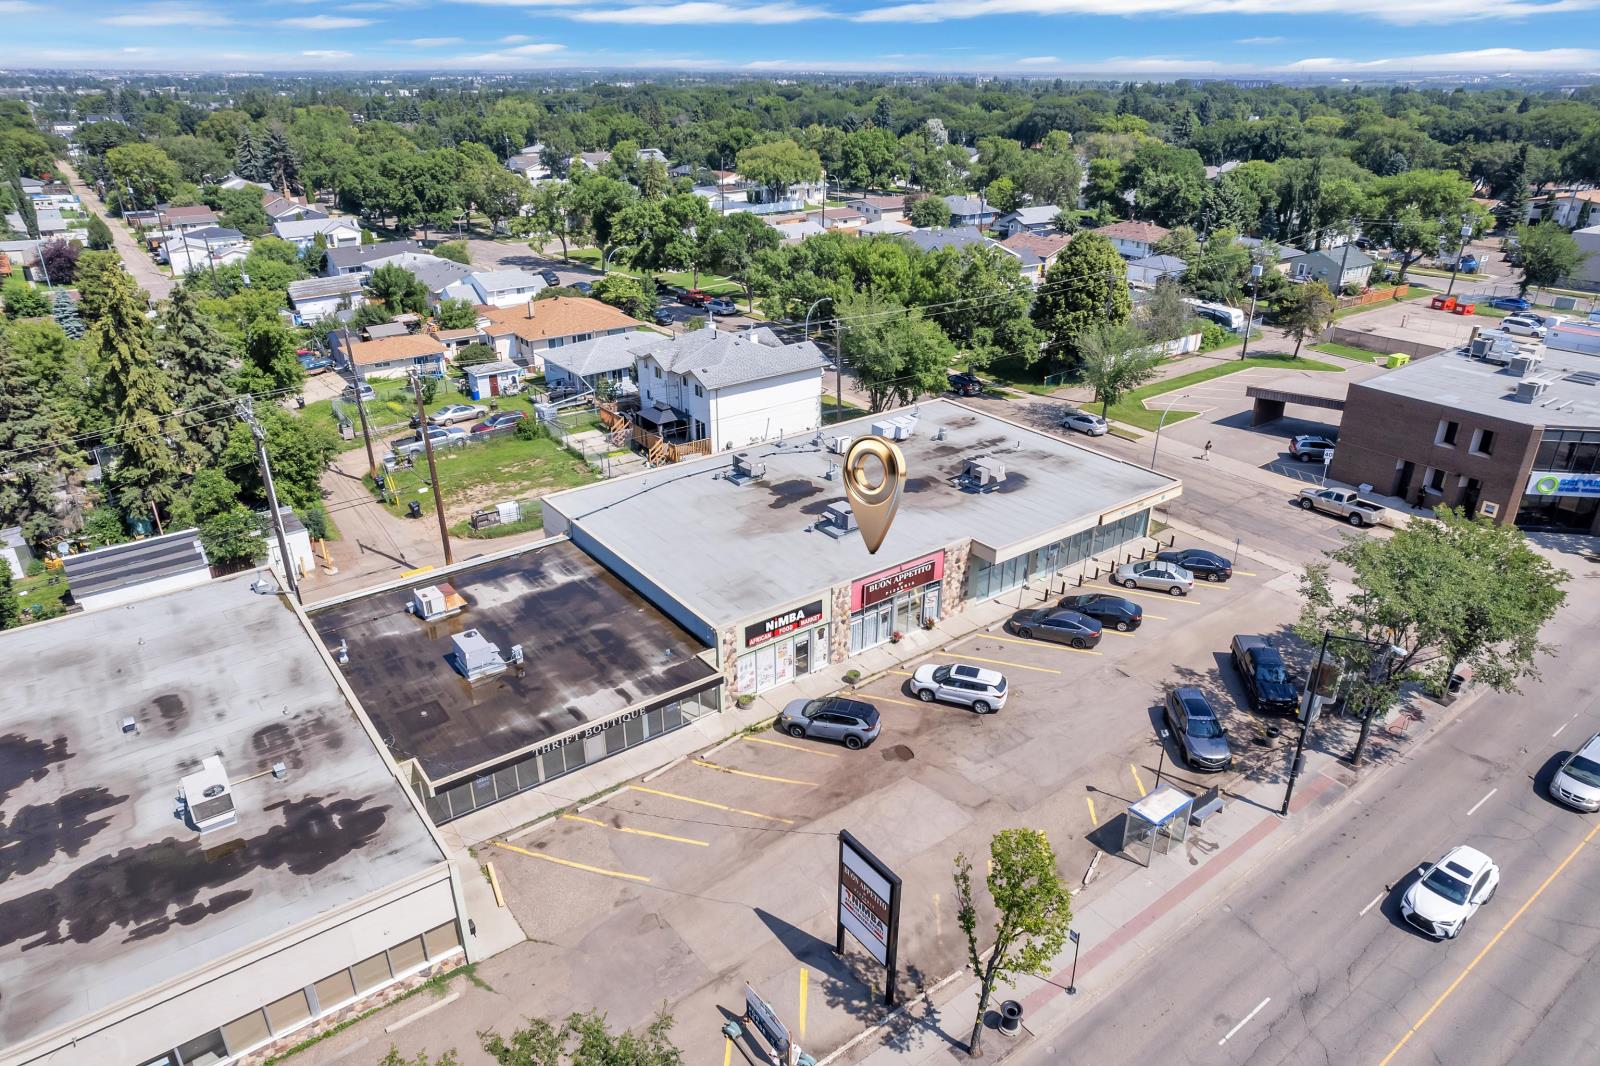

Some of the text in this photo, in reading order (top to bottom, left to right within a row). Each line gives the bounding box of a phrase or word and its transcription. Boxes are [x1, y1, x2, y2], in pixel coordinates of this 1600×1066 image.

[869, 564, 932, 593] BUON APPETITO
[749, 614, 821, 646] AFRICAN FOOD MARKET
[532, 706, 647, 757] THRIFT BOUTIQUE
[860, 882, 887, 911] APPETITO
